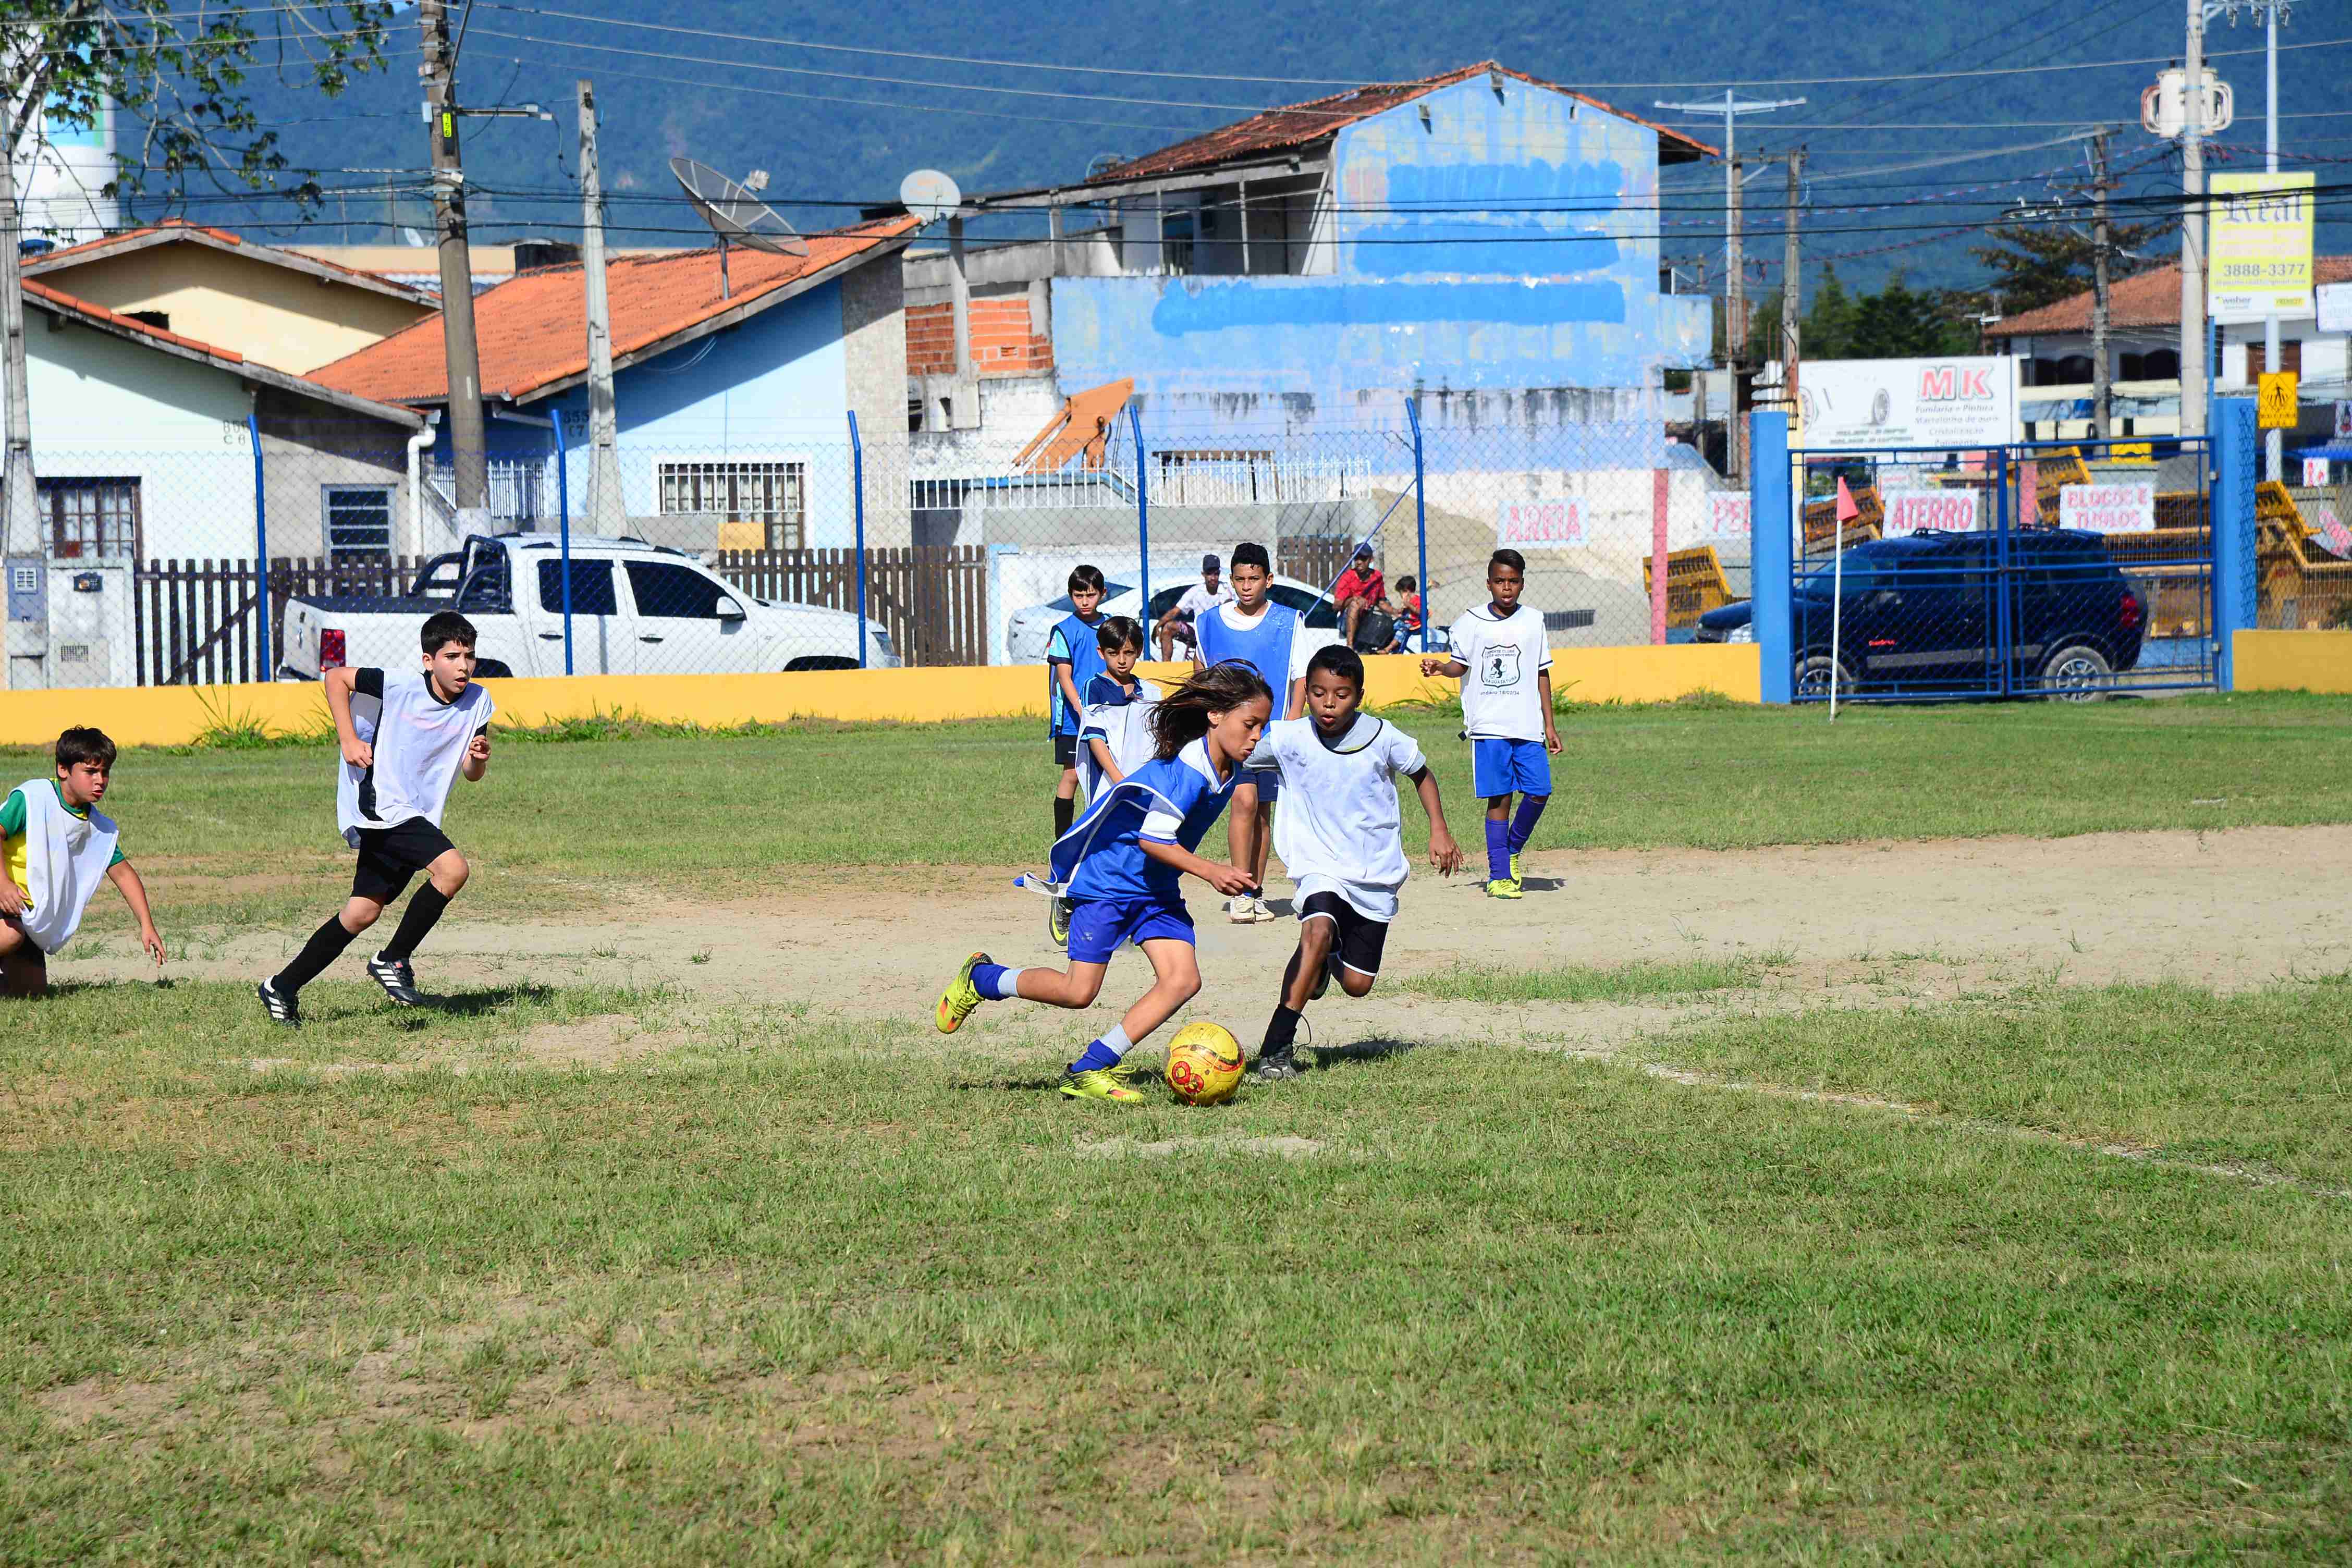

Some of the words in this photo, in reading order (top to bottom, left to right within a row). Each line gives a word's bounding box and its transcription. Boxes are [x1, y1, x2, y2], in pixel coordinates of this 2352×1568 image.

[2221, 191, 2303, 222] Real
[2223, 263, 2305, 277] 3888-3377
[1918, 366, 1995, 401] MK
[1915, 416, 1963, 425] Martelinho
[1965, 415, 1977, 423] de
[2138, 487, 2148, 506] E
[1505, 504, 1581, 542] AREIA
[1892, 496, 1973, 529] ATERRO
